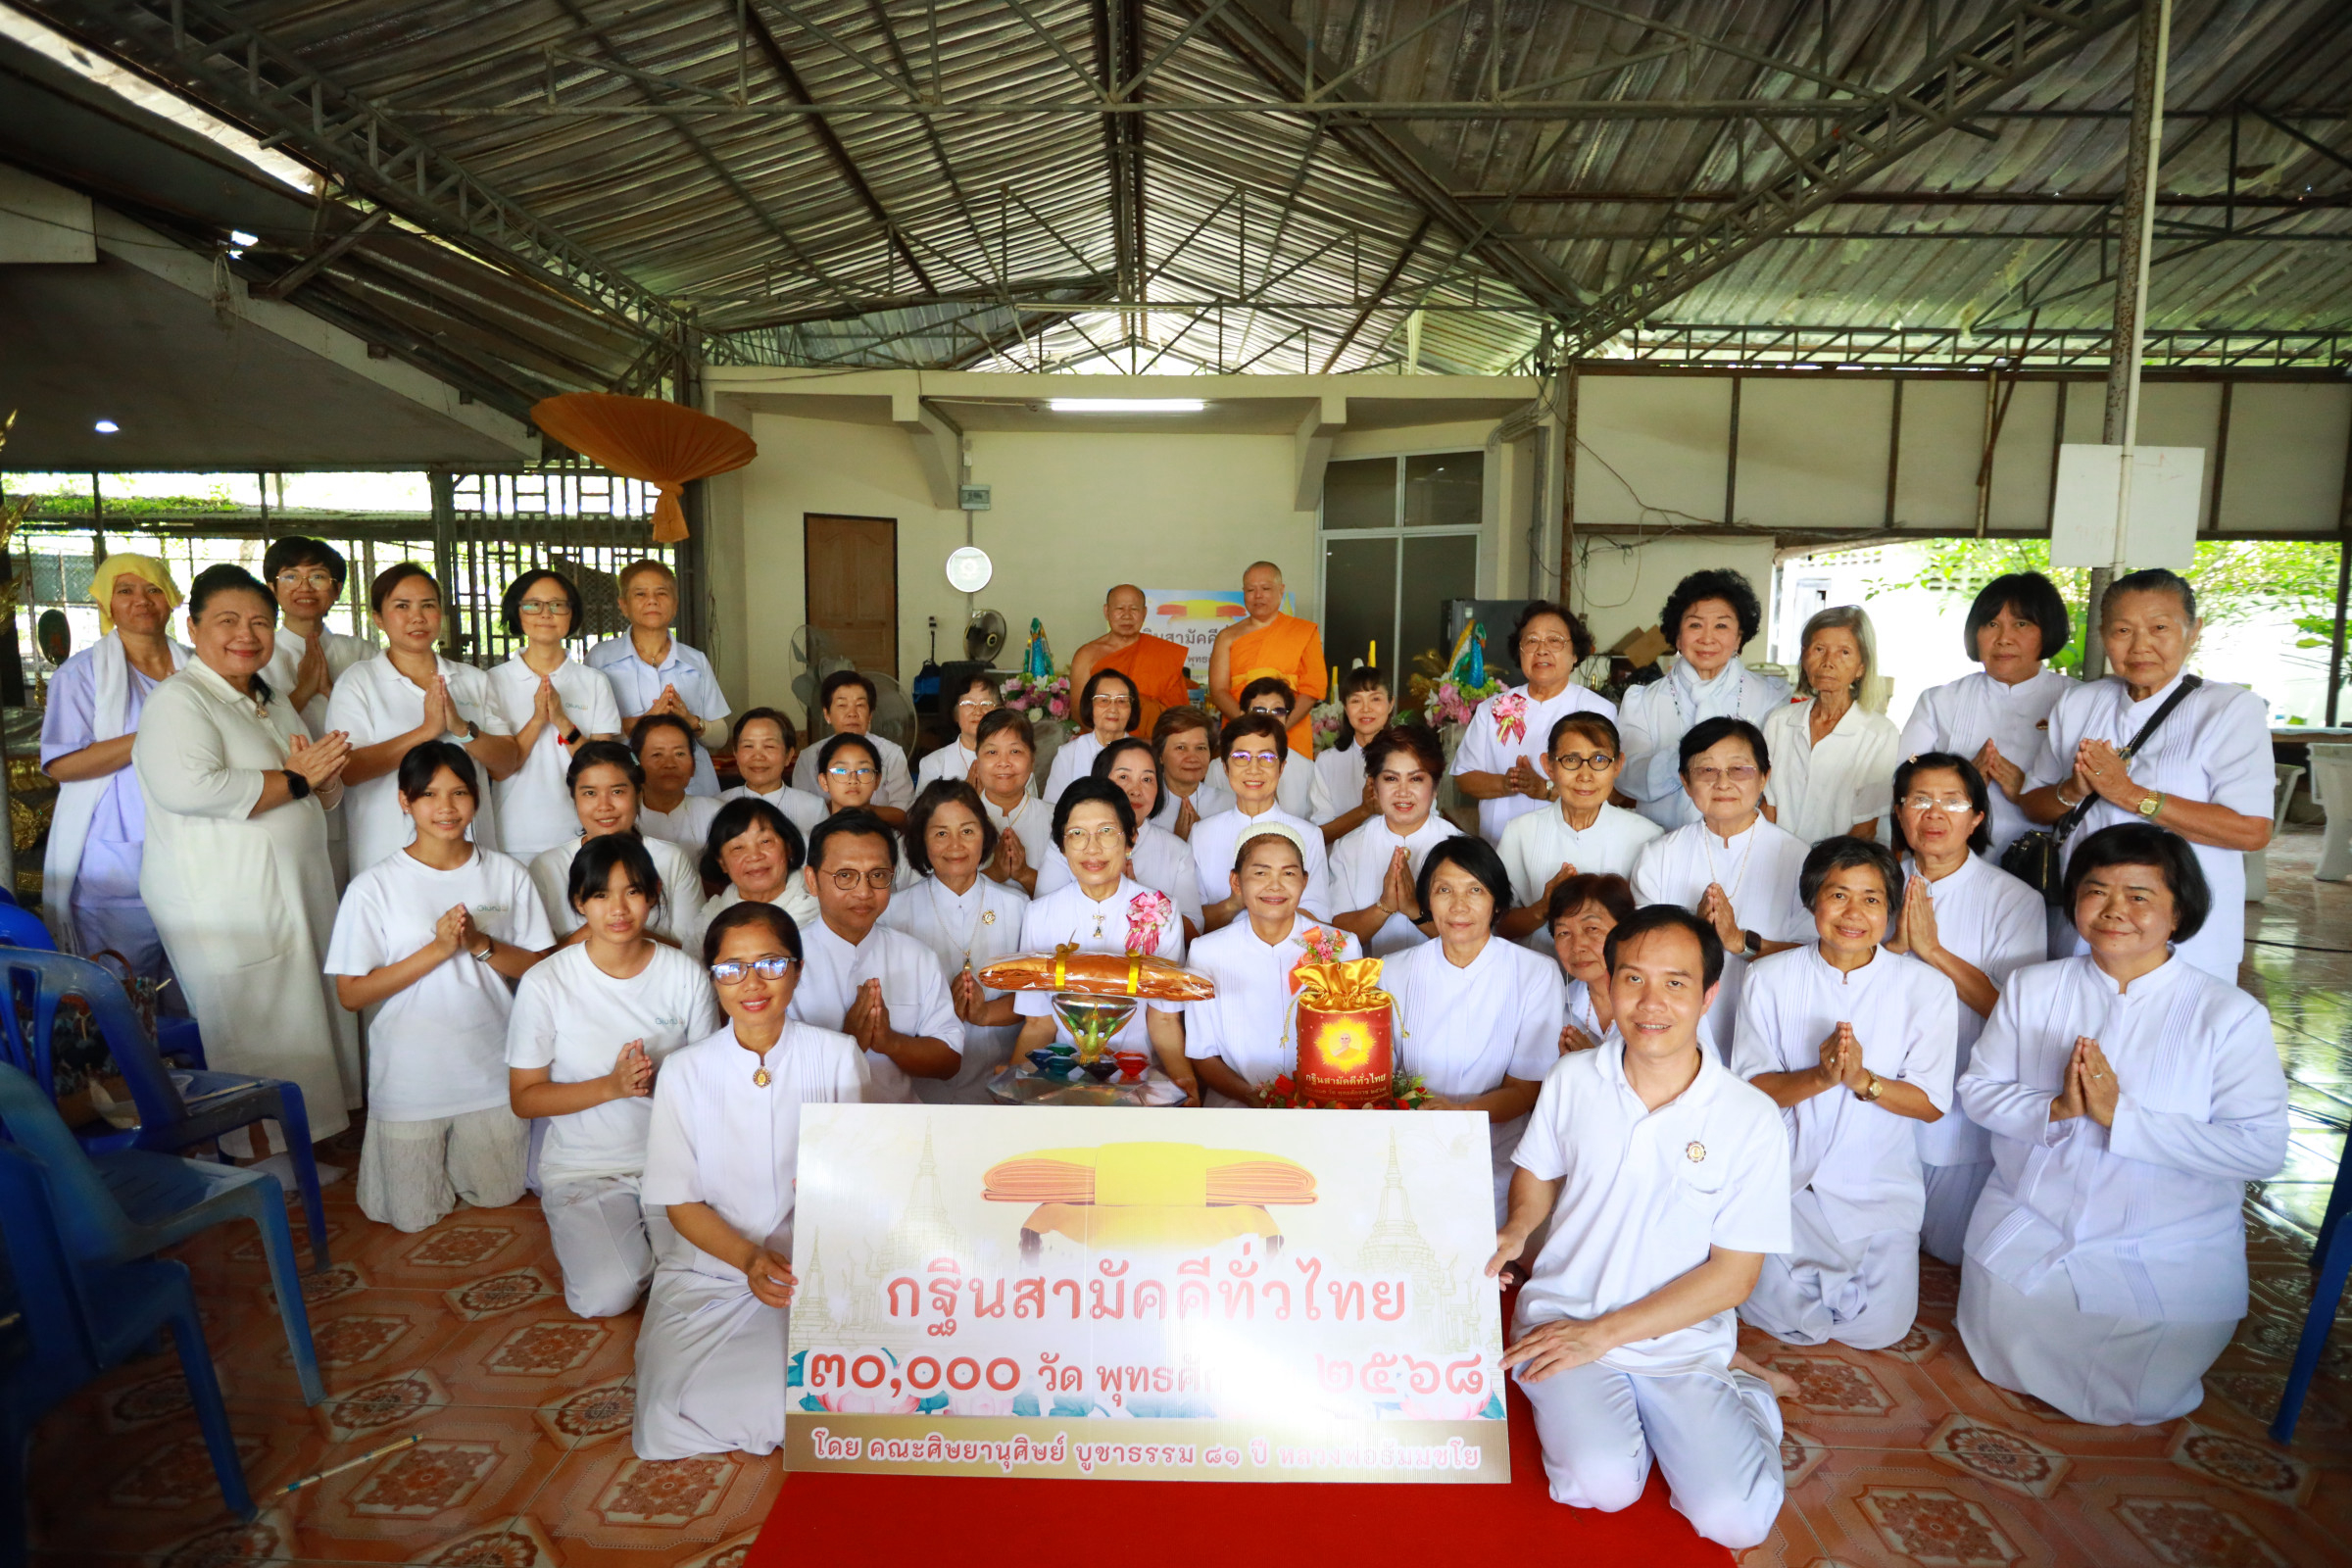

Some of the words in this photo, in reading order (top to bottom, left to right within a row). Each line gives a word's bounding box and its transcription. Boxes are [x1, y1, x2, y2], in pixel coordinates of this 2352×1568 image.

[887, 1242, 1405, 1337] กฐินสามัคคีทั่วไทย
[809, 1352, 1021, 1398] ๓๐,๐๐๐
[1037, 1351, 1083, 1393] วัด
[1314, 1350, 1485, 1395] ๒๕๖๘
[814, 1431, 860, 1458] โดย
[869, 1435, 1065, 1470] คณะศิษยานุศิษย์
[1077, 1443, 1194, 1471] บูชาธรรม
[1204, 1446, 1241, 1465] ๘๑
[1250, 1439, 1268, 1464] ปี
